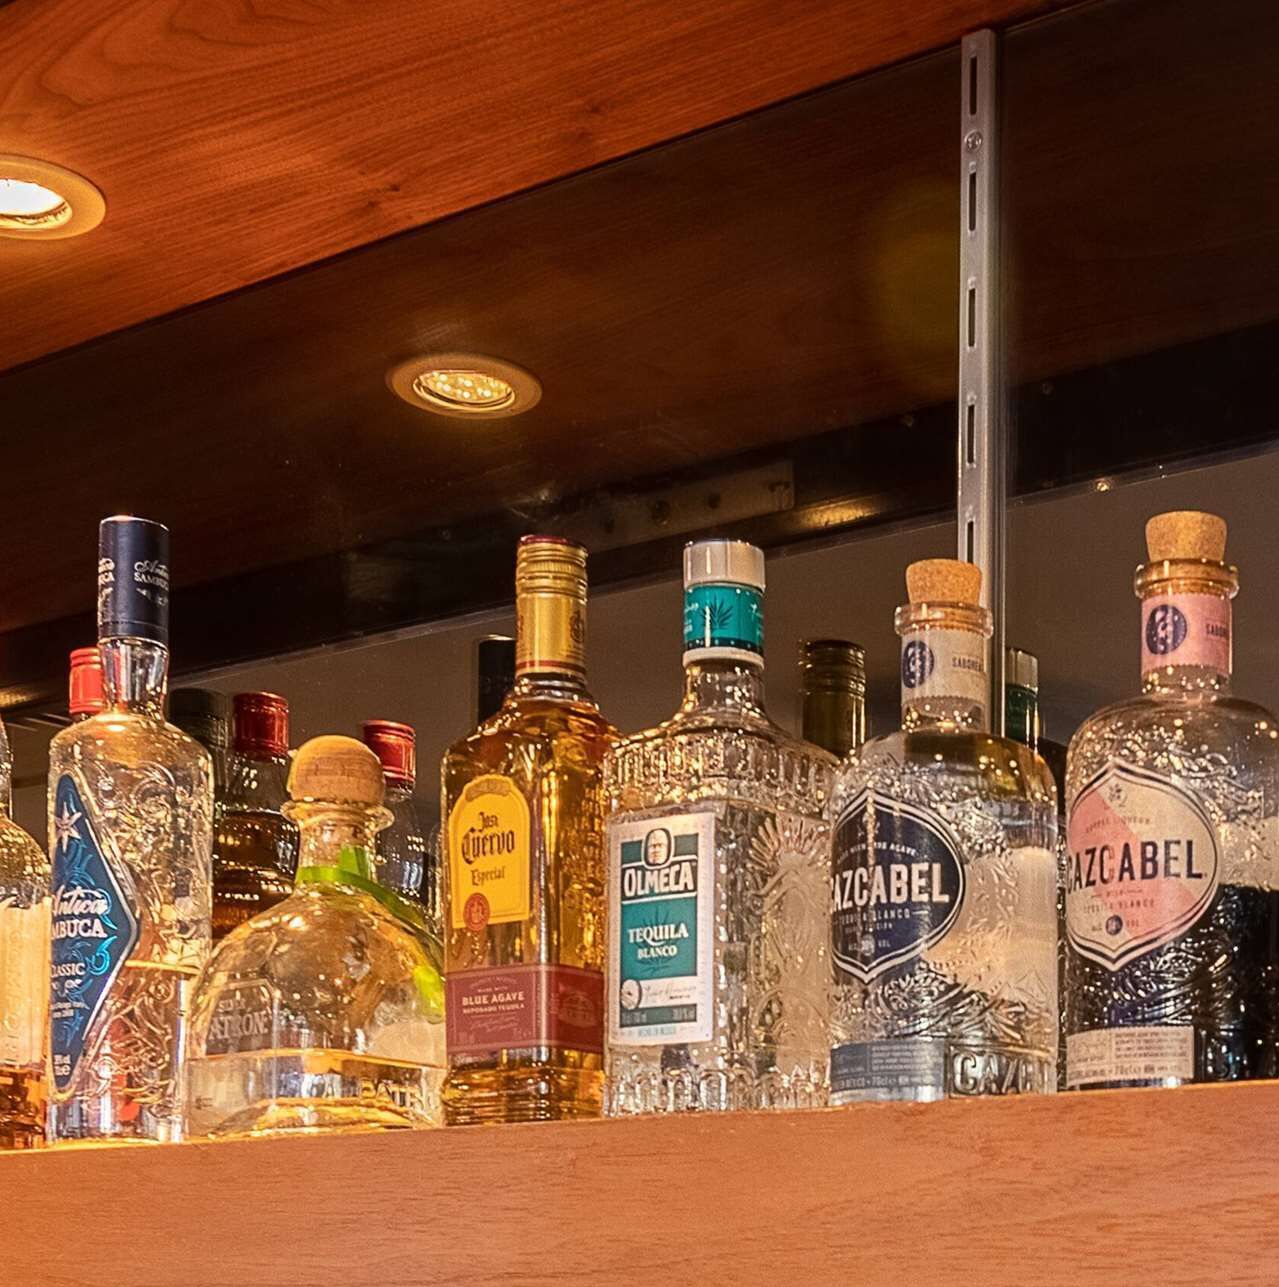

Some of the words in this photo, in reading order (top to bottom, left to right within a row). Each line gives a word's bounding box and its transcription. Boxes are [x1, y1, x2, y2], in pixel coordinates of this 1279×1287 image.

[460, 827, 516, 865] Cuervo
[471, 866, 506, 887] Especial
[623, 861, 695, 897] OLMECA
[628, 922, 689, 947] TEQUILA
[637, 944, 678, 960] BLANCO
[461, 992, 489, 1007] BLUE
[491, 990, 525, 1004] AGAVE
